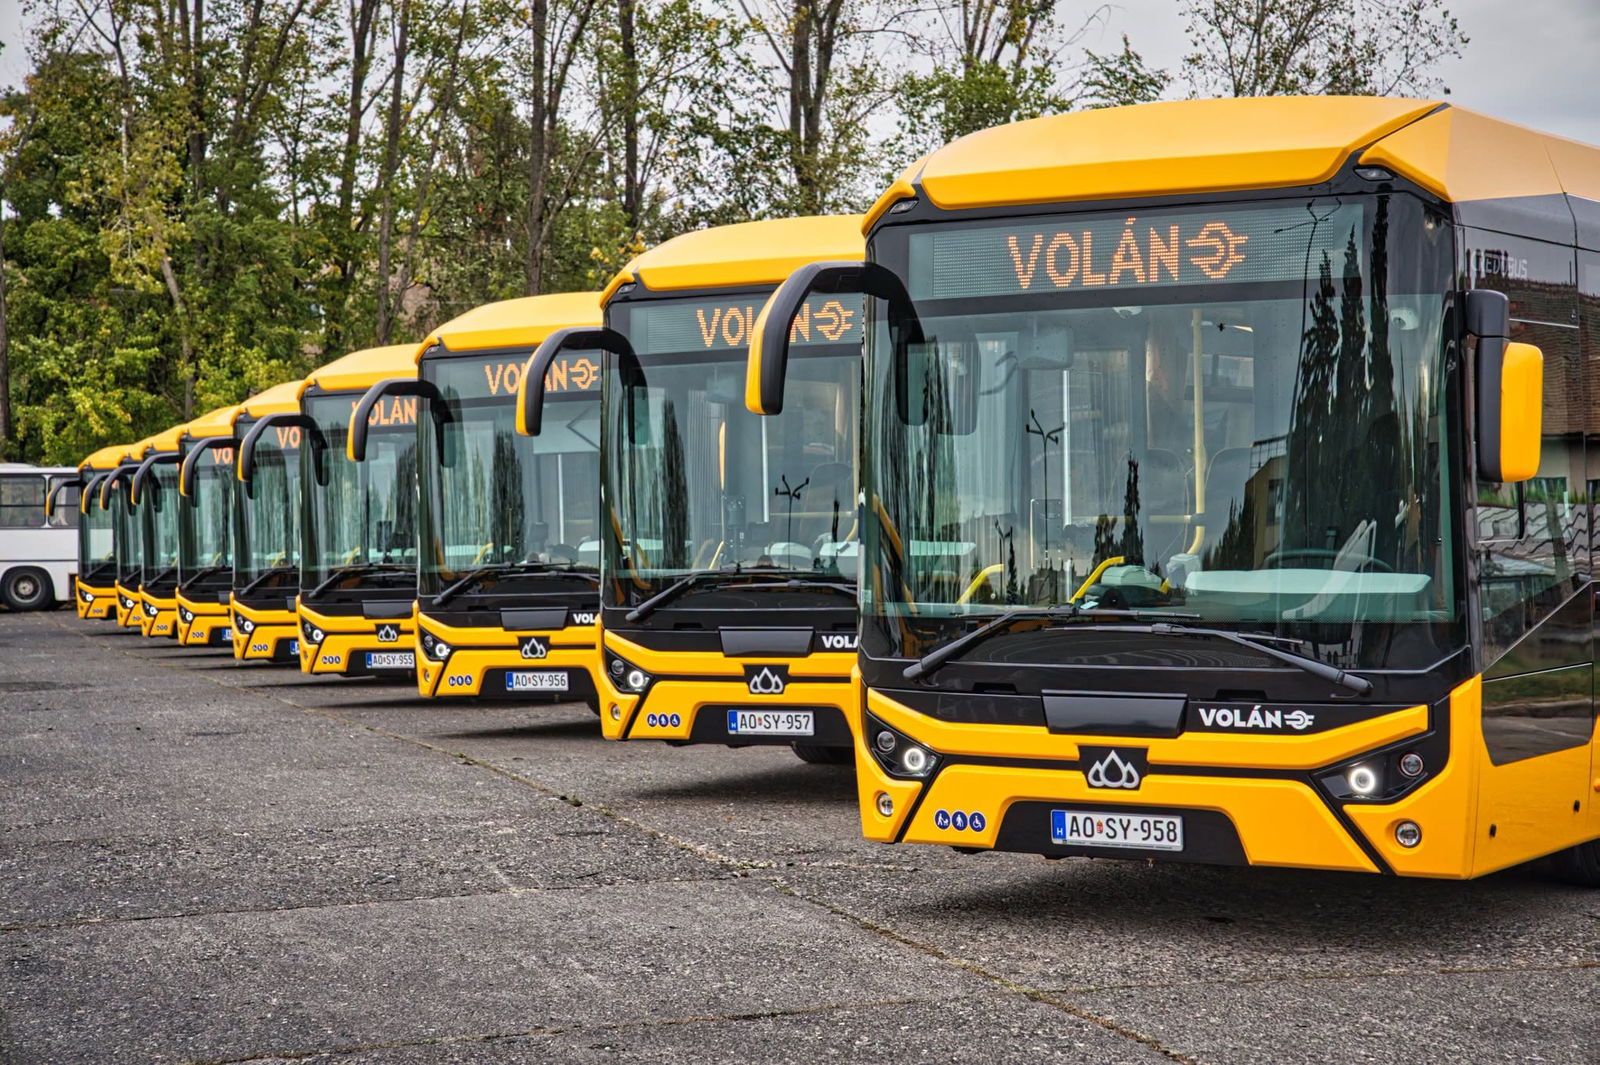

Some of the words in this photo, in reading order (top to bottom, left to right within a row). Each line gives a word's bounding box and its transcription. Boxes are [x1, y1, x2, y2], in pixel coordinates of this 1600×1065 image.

[1008, 217, 1180, 289] VOLÁN
[696, 303, 810, 348] VOLN
[1198, 705, 1282, 728] VOLÁN
